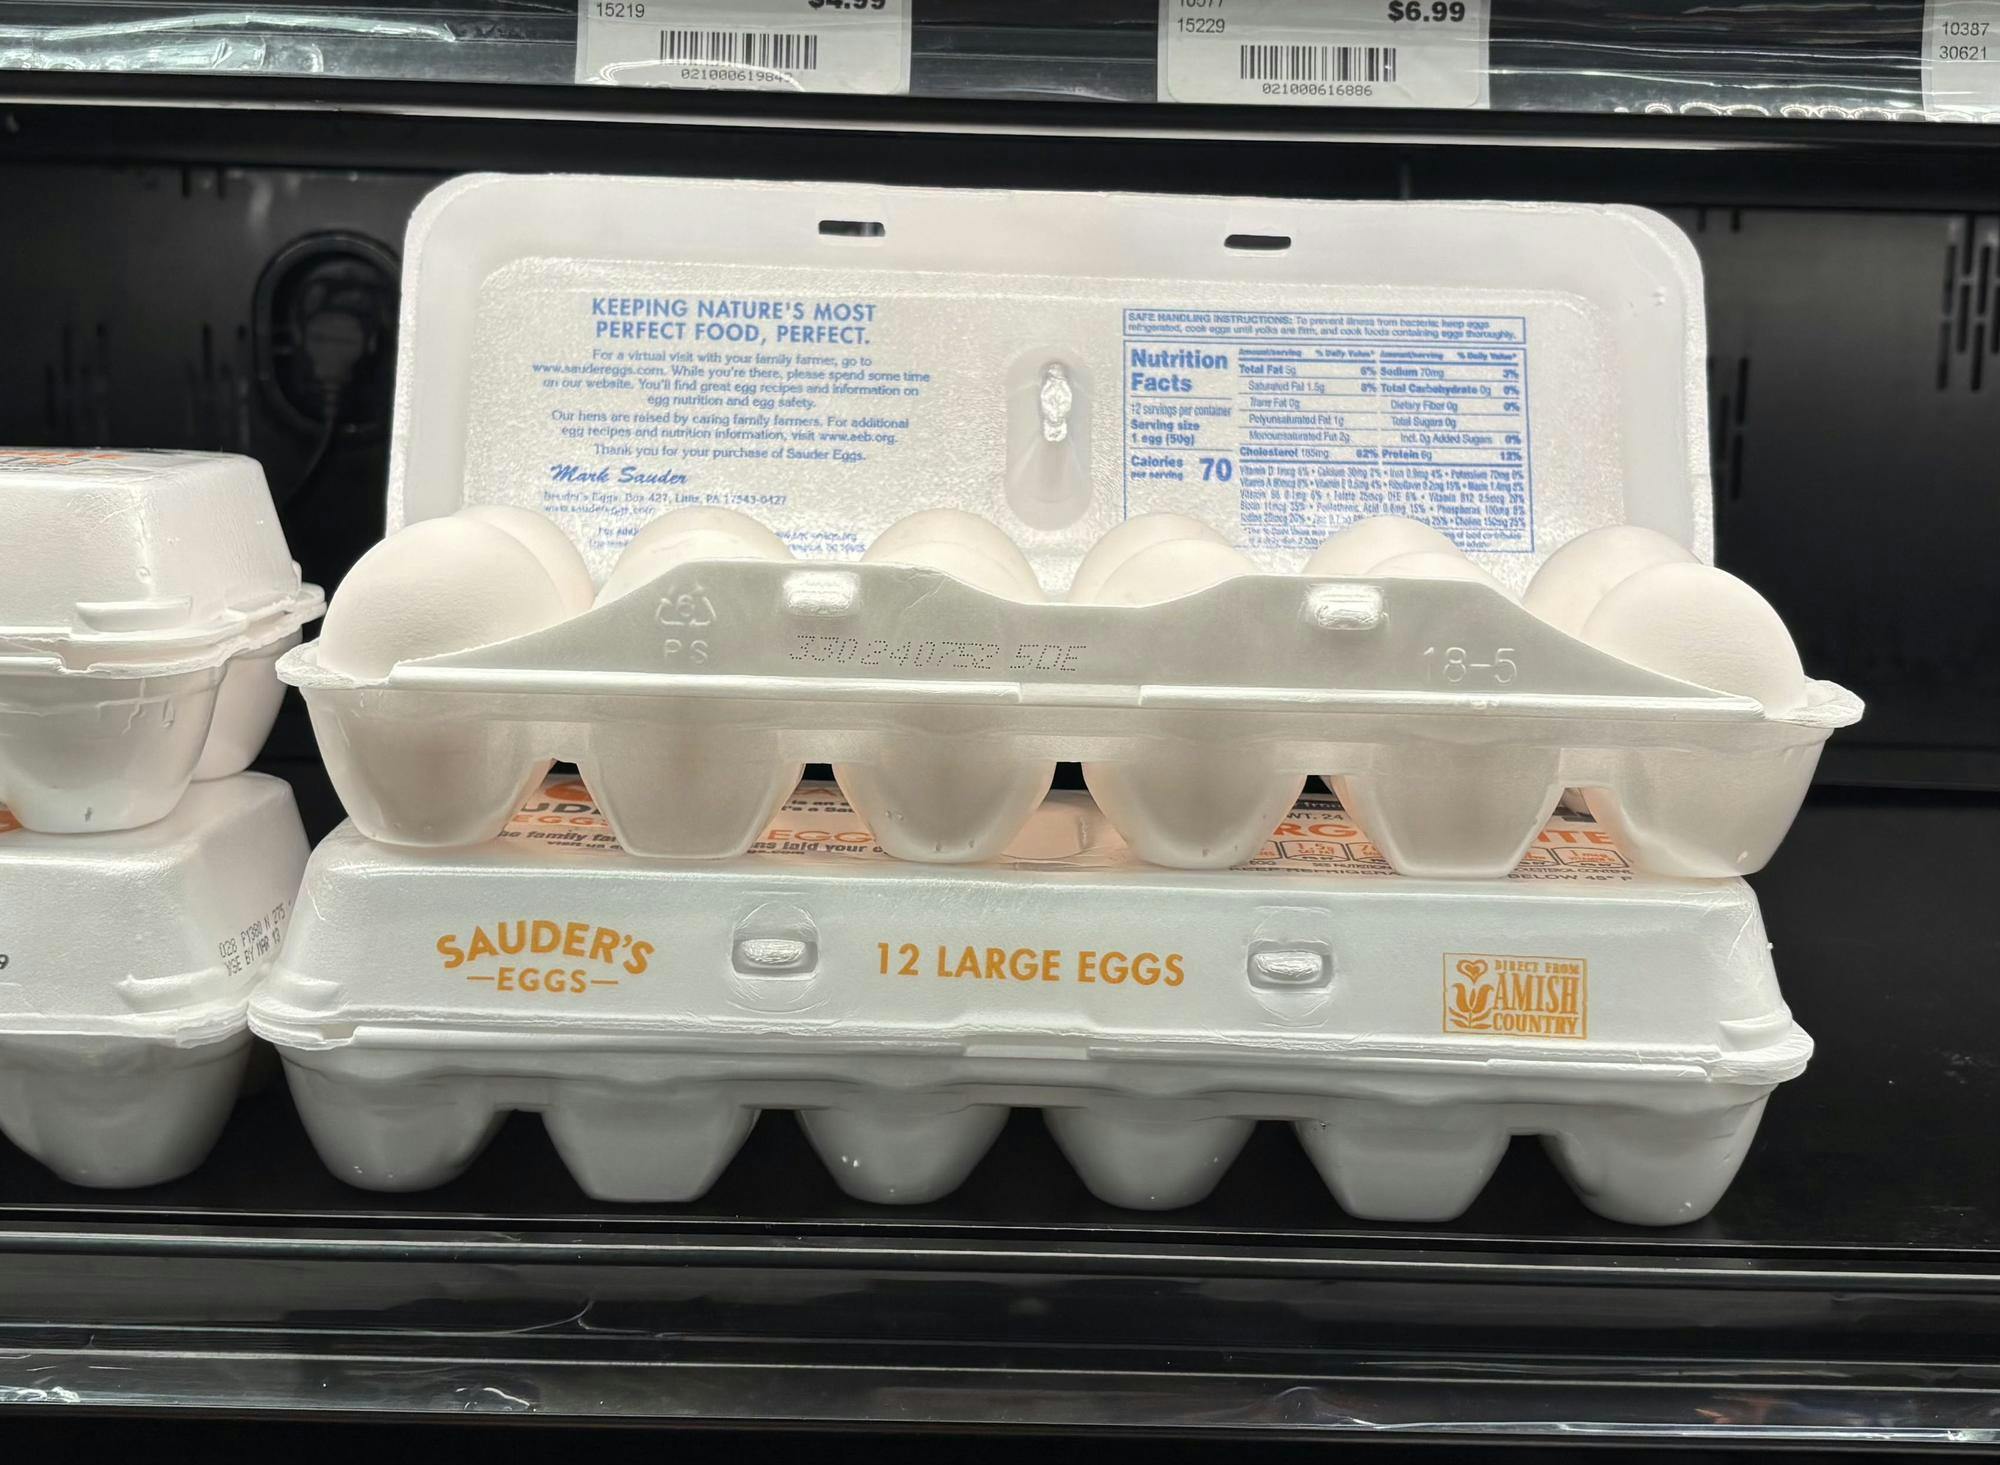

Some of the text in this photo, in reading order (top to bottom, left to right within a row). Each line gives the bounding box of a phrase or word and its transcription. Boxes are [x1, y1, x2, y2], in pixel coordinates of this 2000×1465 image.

[597, 2, 645, 18] 15219
[1388, 0, 1466, 23] $6.99
[1177, 17, 1225, 33] 15229
[1941, 22, 1990, 36] 10387
[1939, 46, 1986, 60] 30621
[1262, 83, 1373, 97] 021000616886
[592, 298, 876, 322] KEEPING NATURE'S MOST
[1128, 313, 1157, 322] SAFE
[1158, 314, 1211, 323] HANDLING
[596, 321, 871, 345] PERFECT FOOD, PERFECT.
[593, 349, 873, 369] For a virtual visit with your family farmer, go to
[1131, 349, 1229, 369] Nutrition
[671, 364, 705, 377] While
[708, 366, 747, 379] you're
[787, 368, 825, 382] please
[828, 369, 865, 383] spend
[868, 372, 901, 382] some
[903, 370, 931, 383] time
[1238, 363, 1297, 377] Total Fat 5g
[1380, 366, 1445, 379] Sodium 70mg
[562, 379, 582, 389] our
[639, 379, 671, 391] You'll
[674, 379, 697, 391] find
[700, 381, 731, 394] great
[734, 382, 757, 394] egg
[760, 382, 804, 395] recipes
[806, 382, 829, 394] and
[832, 383, 901, 396] information
[904, 386, 920, 396] on
[1131, 372, 1193, 392] Facts
[1248, 380, 1325, 394] Saturated Fat 1.5g
[1380, 384, 1492, 396] Total Carbohydrate 0g
[647, 394, 816, 410] egg nutrition and egg safety.
[1273, 397, 1287, 408] Fat
[1390, 400, 1445, 411] Dietary Fiber
[552, 410, 574, 422] Our
[578, 411, 607, 422] hens
[611, 413, 630, 423] are
[633, 411, 670, 423] raised
[674, 412, 689, 426] by
[692, 412, 730, 427] caring
[733, 413, 770, 428] family
[827, 416, 847, 427] For
[851, 417, 909, 429] additional
[1130, 418, 1201, 432] Serving size
[1391, 416, 1411, 427] Total
[561, 427, 584, 438] egg
[588, 426, 632, 439] recipes
[635, 426, 658, 438] and
[661, 427, 711, 440] nutrition
[715, 428, 787, 441] information,
[791, 430, 815, 441] visit
[1141, 433, 1195, 447] egg (50g)
[1432, 434, 1461, 444] Added
[594, 443, 867, 463] Thank you for your purchase of Sauder Eggs.
[1239, 446, 1298, 457] Cholesterol
[1381, 449, 1433, 461] Protein 6g
[1130, 455, 1184, 468] Calories
[1199, 457, 1233, 482] 70
[550, 463, 688, 485] Mark Sauder
[767, 829, 873, 843] EGG
[436, 920, 656, 975] SAUDER'S
[878, 942, 1185, 987] 12 LARGE EGGS
[1494, 959, 1581, 975] DIRECT FROM
[497, 967, 587, 993] EGGS
[1492, 972, 1579, 1014] AMISH
[1492, 1012, 1579, 1035] COUNTRY
